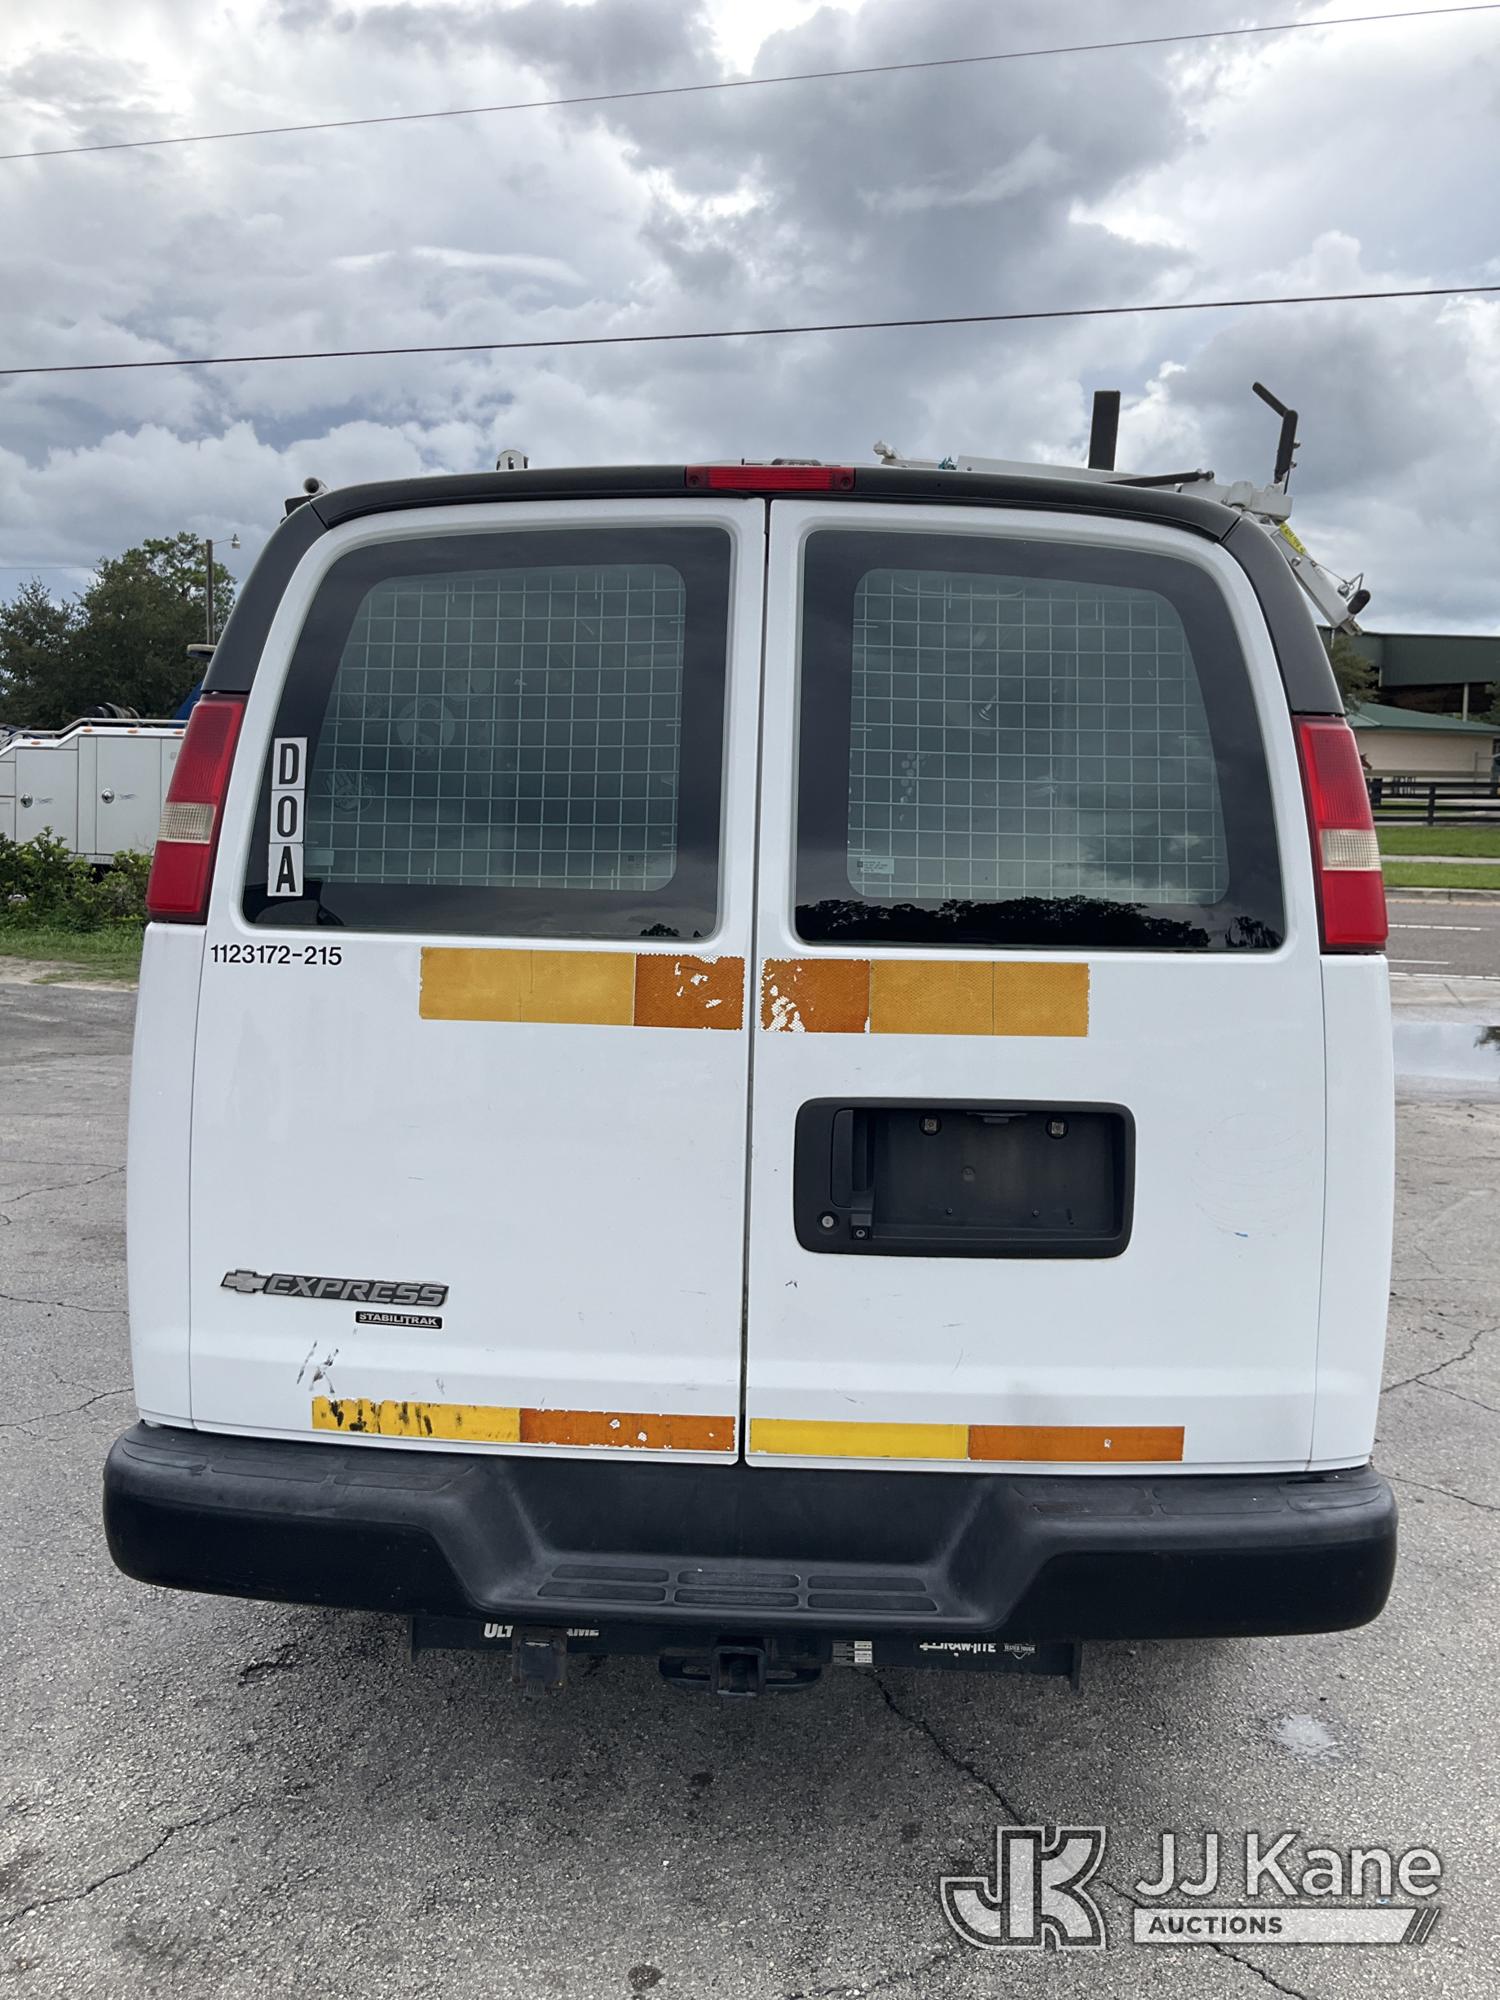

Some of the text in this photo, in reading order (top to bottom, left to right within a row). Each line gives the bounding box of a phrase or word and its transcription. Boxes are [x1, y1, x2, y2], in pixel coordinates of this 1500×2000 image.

[275, 742, 300, 893] DOA
[210, 944, 342, 966] 1123172-215
[265, 1274, 446, 1307] EXPRESS
[359, 1312, 438, 1326] STABILITRAK
[483, 1622, 514, 1638] ULT
